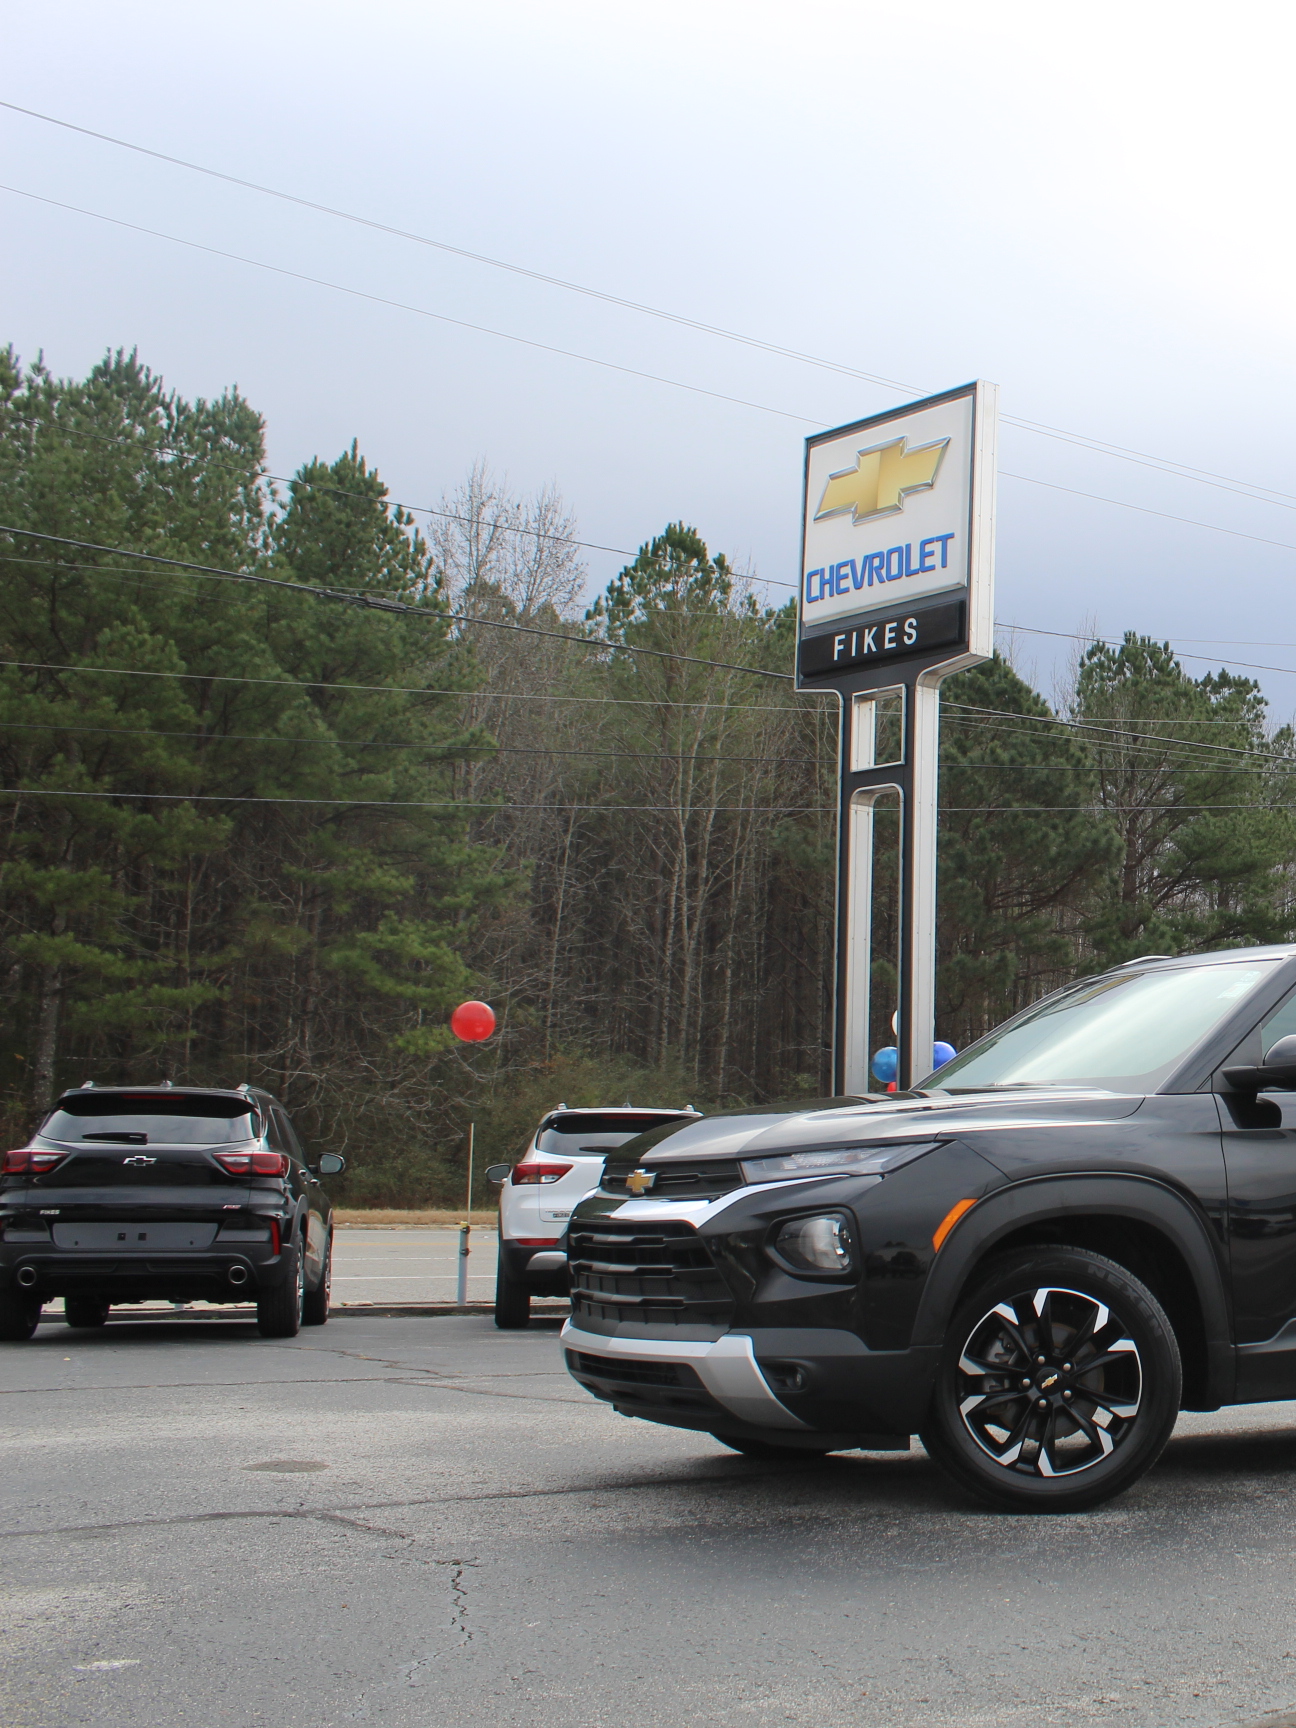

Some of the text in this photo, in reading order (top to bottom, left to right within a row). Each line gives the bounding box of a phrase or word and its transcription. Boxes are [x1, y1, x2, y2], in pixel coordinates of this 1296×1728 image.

[806, 532, 955, 603] CHEVROLET
[833, 617, 918, 661] FIKES
[1087, 1264, 1163, 1337] NEXEN
